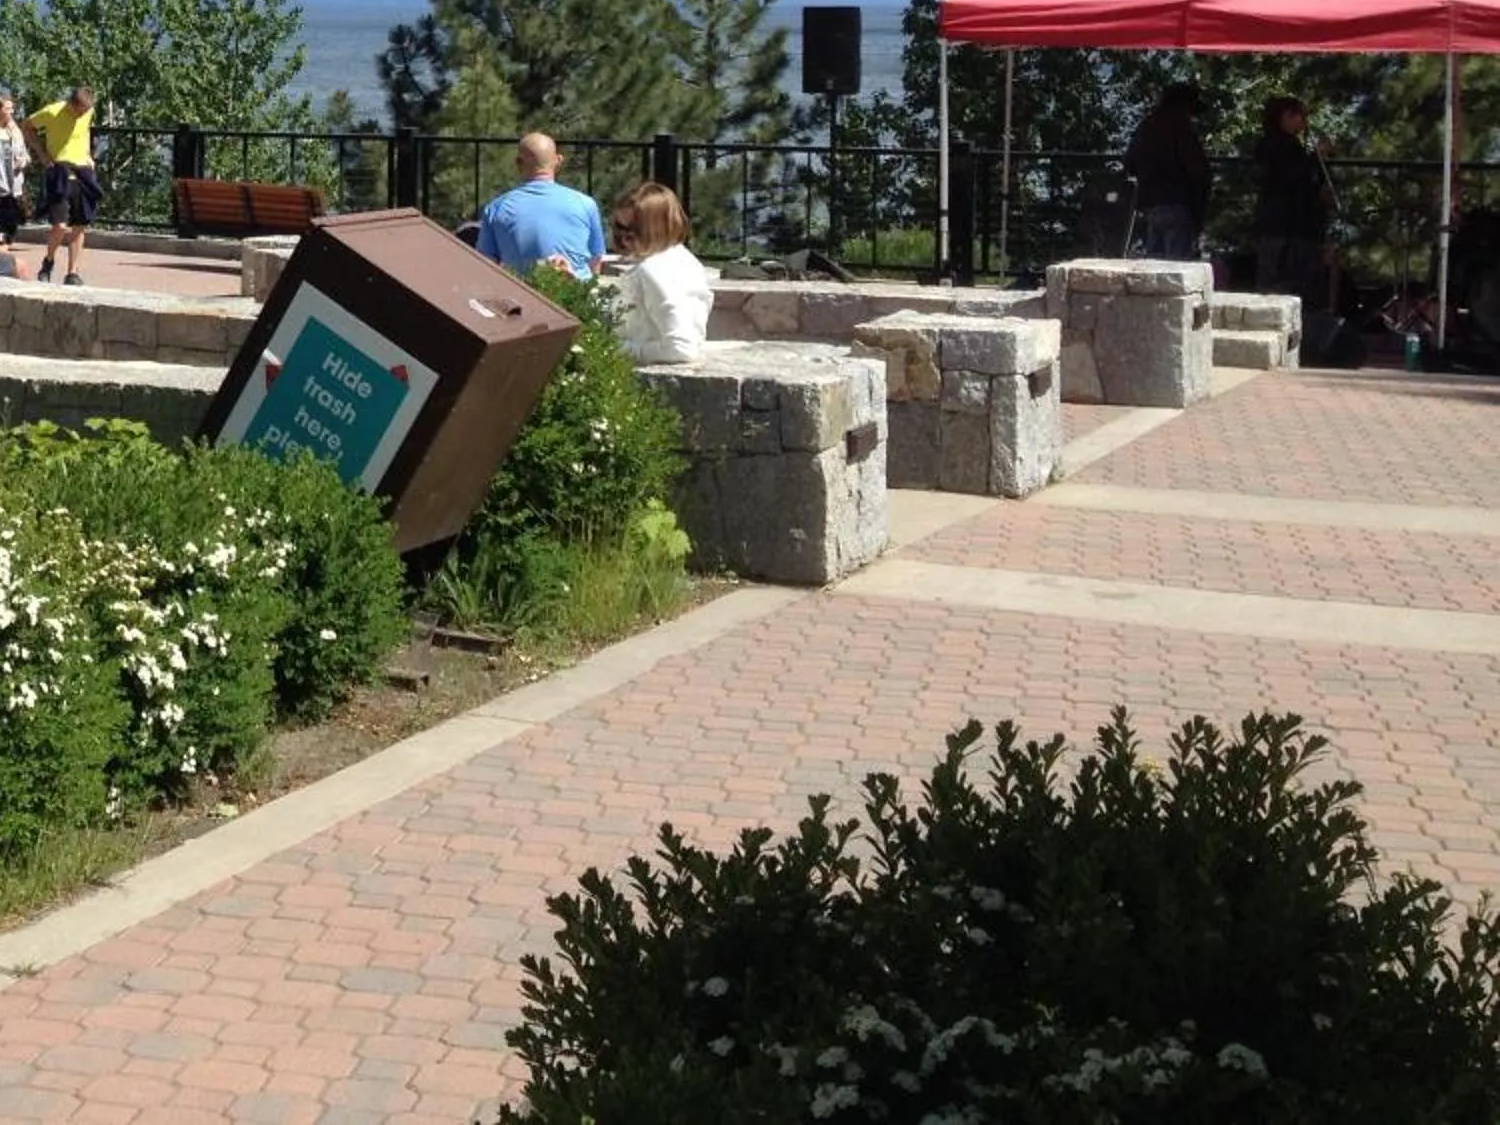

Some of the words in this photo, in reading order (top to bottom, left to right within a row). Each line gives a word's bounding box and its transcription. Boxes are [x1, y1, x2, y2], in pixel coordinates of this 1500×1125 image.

[322, 352, 373, 399] Hide
[303, 375, 357, 426] trash
[263, 424, 300, 456] ple
